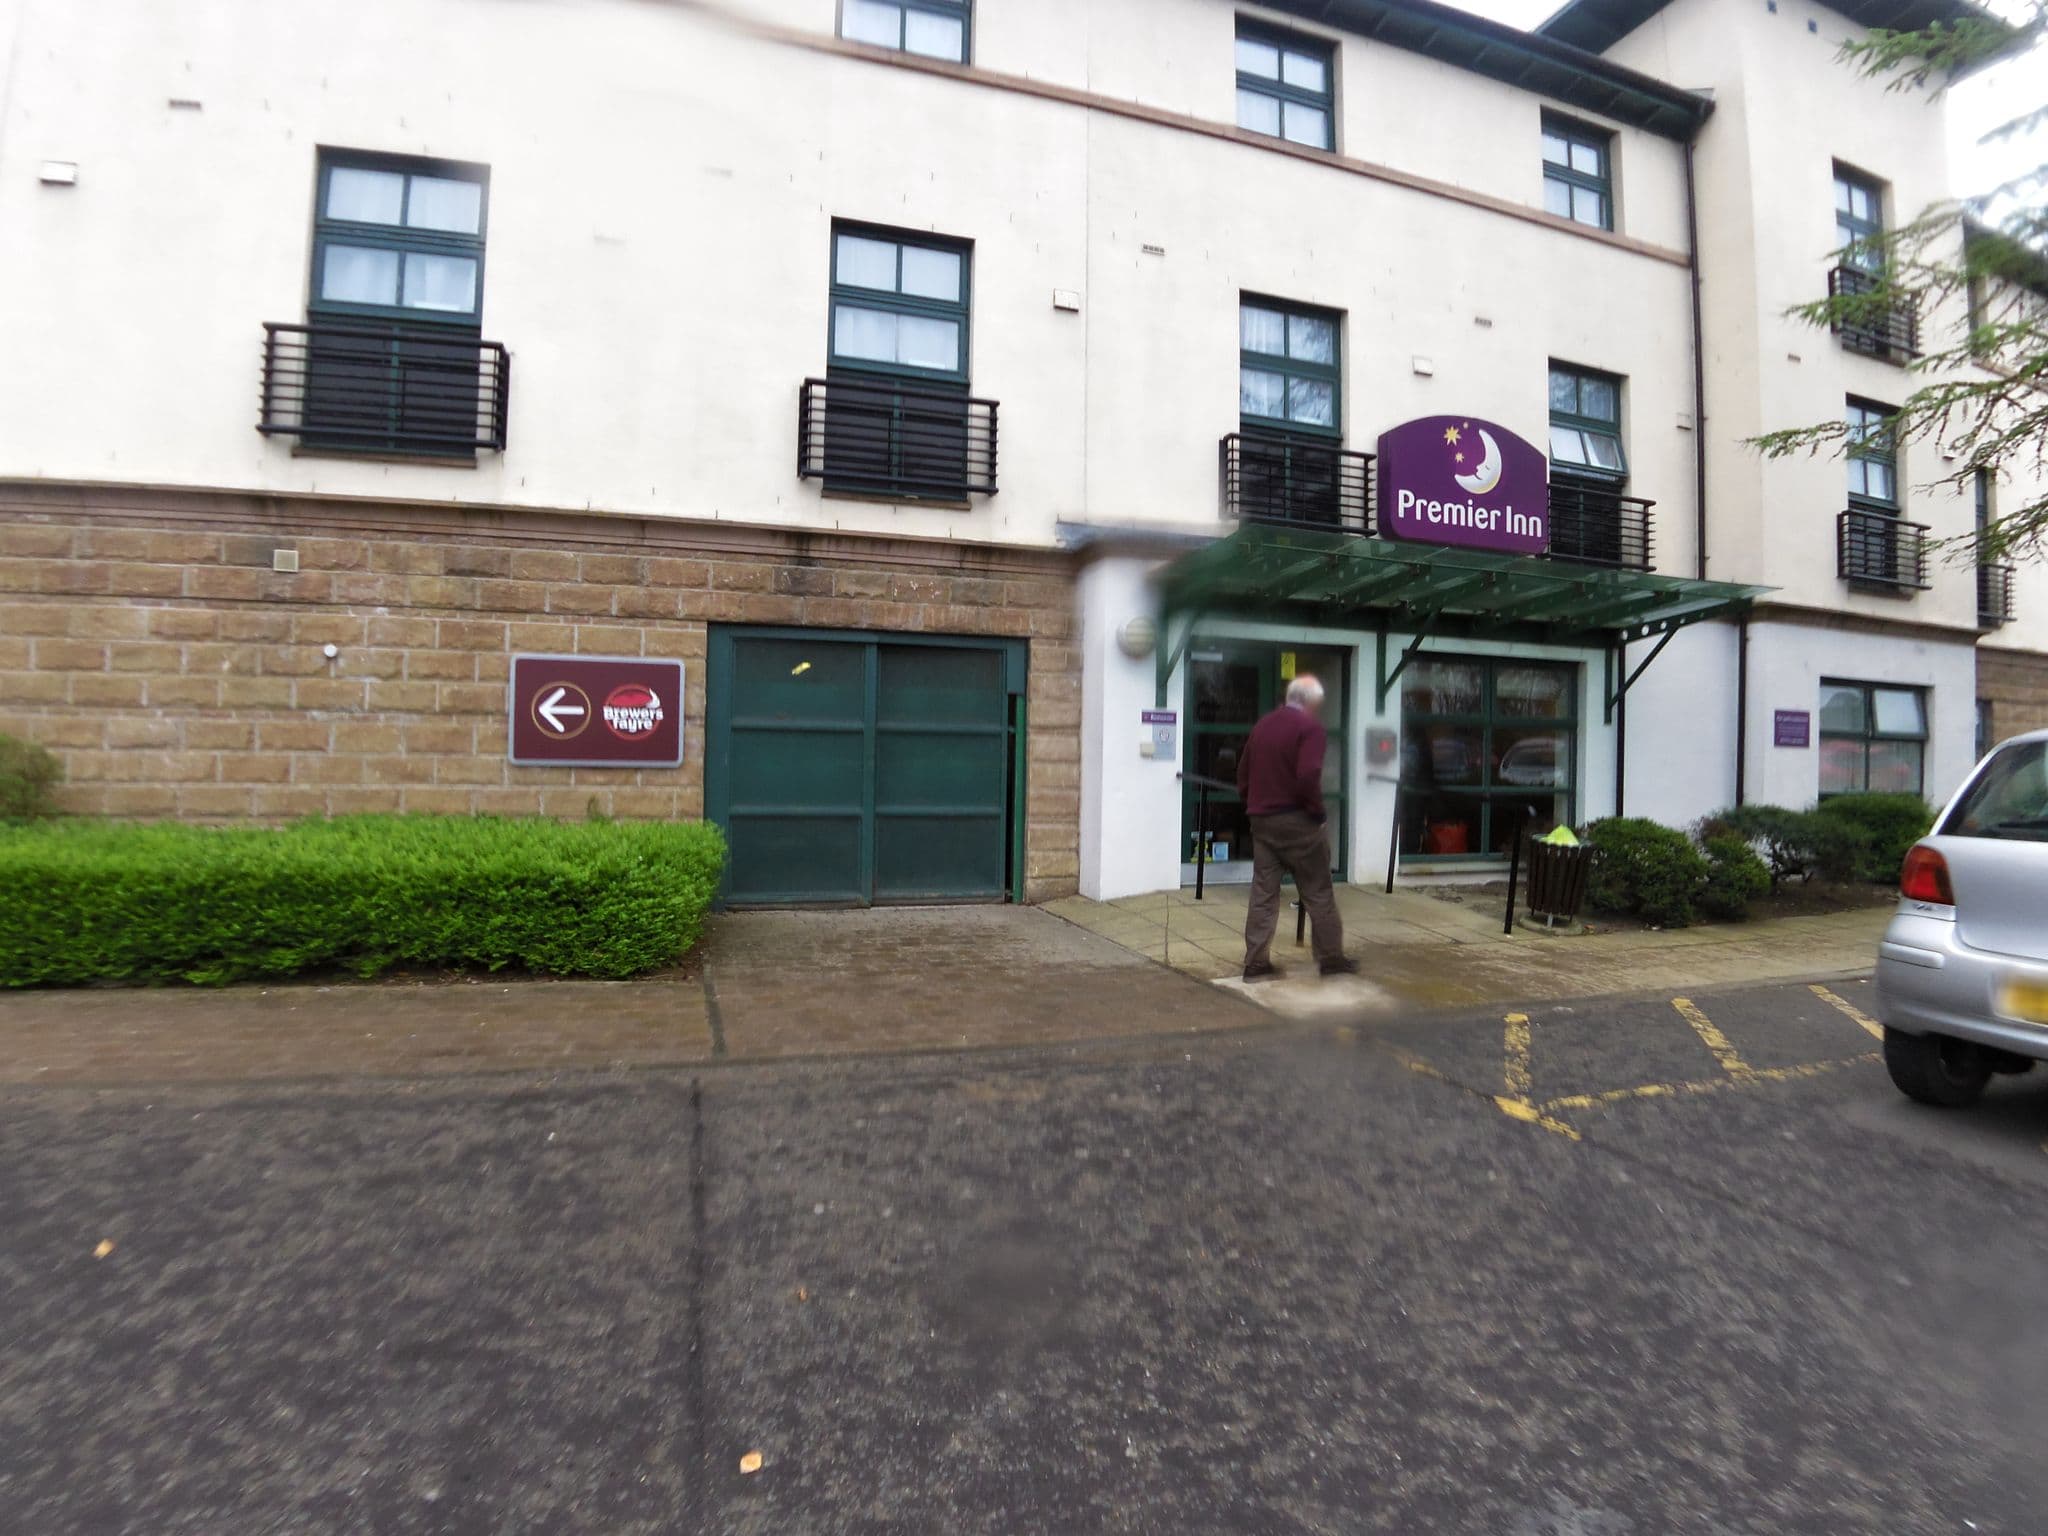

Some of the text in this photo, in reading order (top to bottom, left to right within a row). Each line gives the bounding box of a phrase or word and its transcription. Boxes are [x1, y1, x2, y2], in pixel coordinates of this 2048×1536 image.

[1398, 489, 1542, 538] Premier Inn
[603, 705, 663, 721] Brewers
